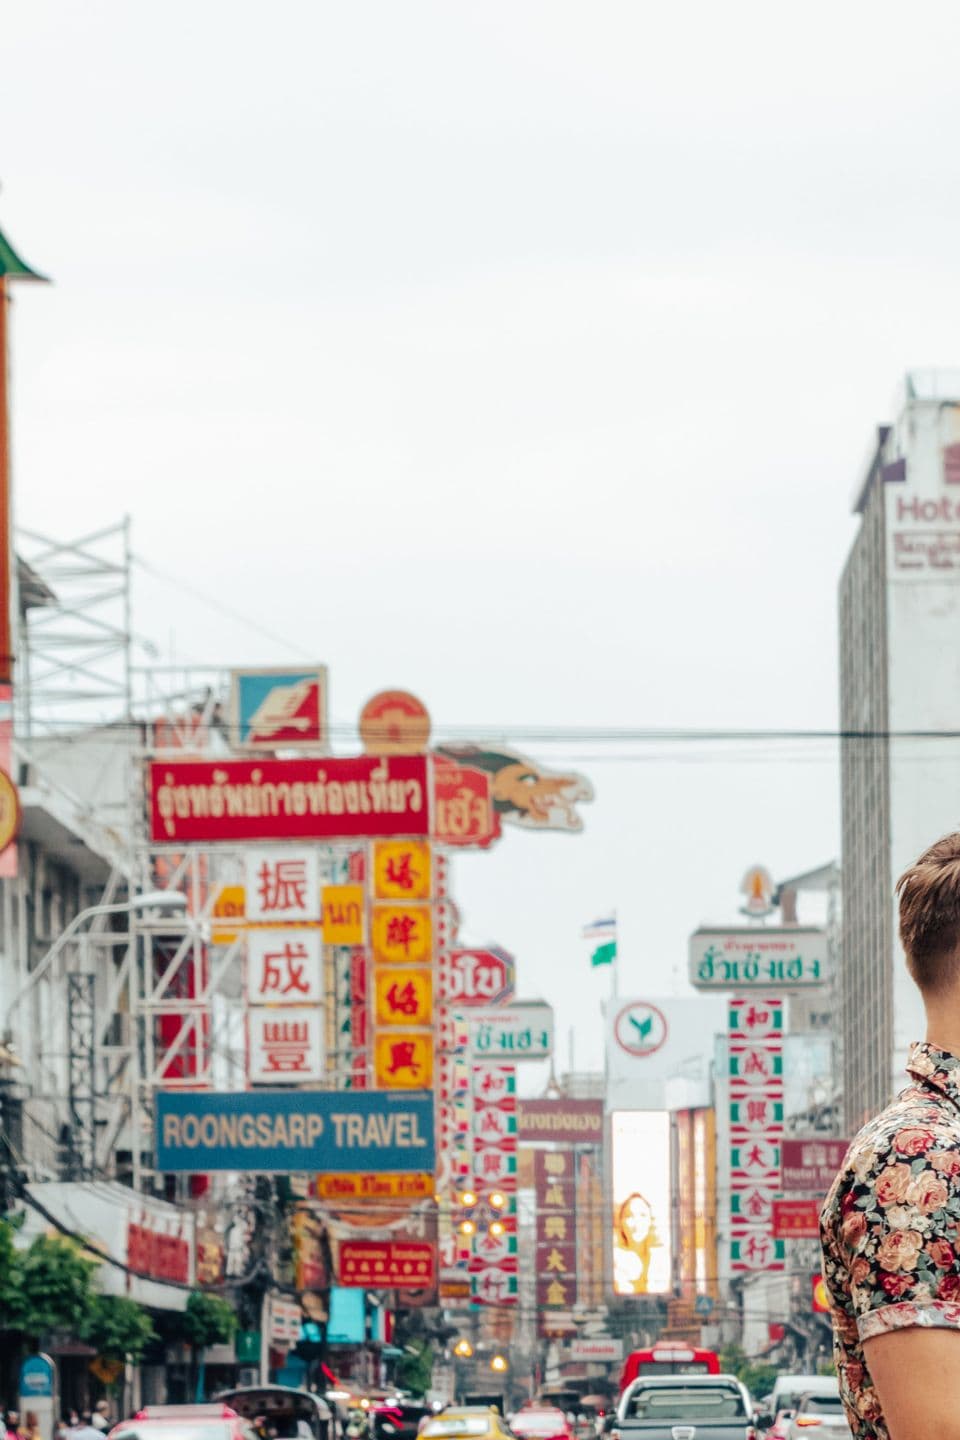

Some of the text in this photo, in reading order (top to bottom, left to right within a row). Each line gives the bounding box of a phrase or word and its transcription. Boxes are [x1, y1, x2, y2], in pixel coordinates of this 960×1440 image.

[258, 859, 312, 1073] 振成豐
[163, 1111, 427, 1149] ROONGSARP TRAVEL
